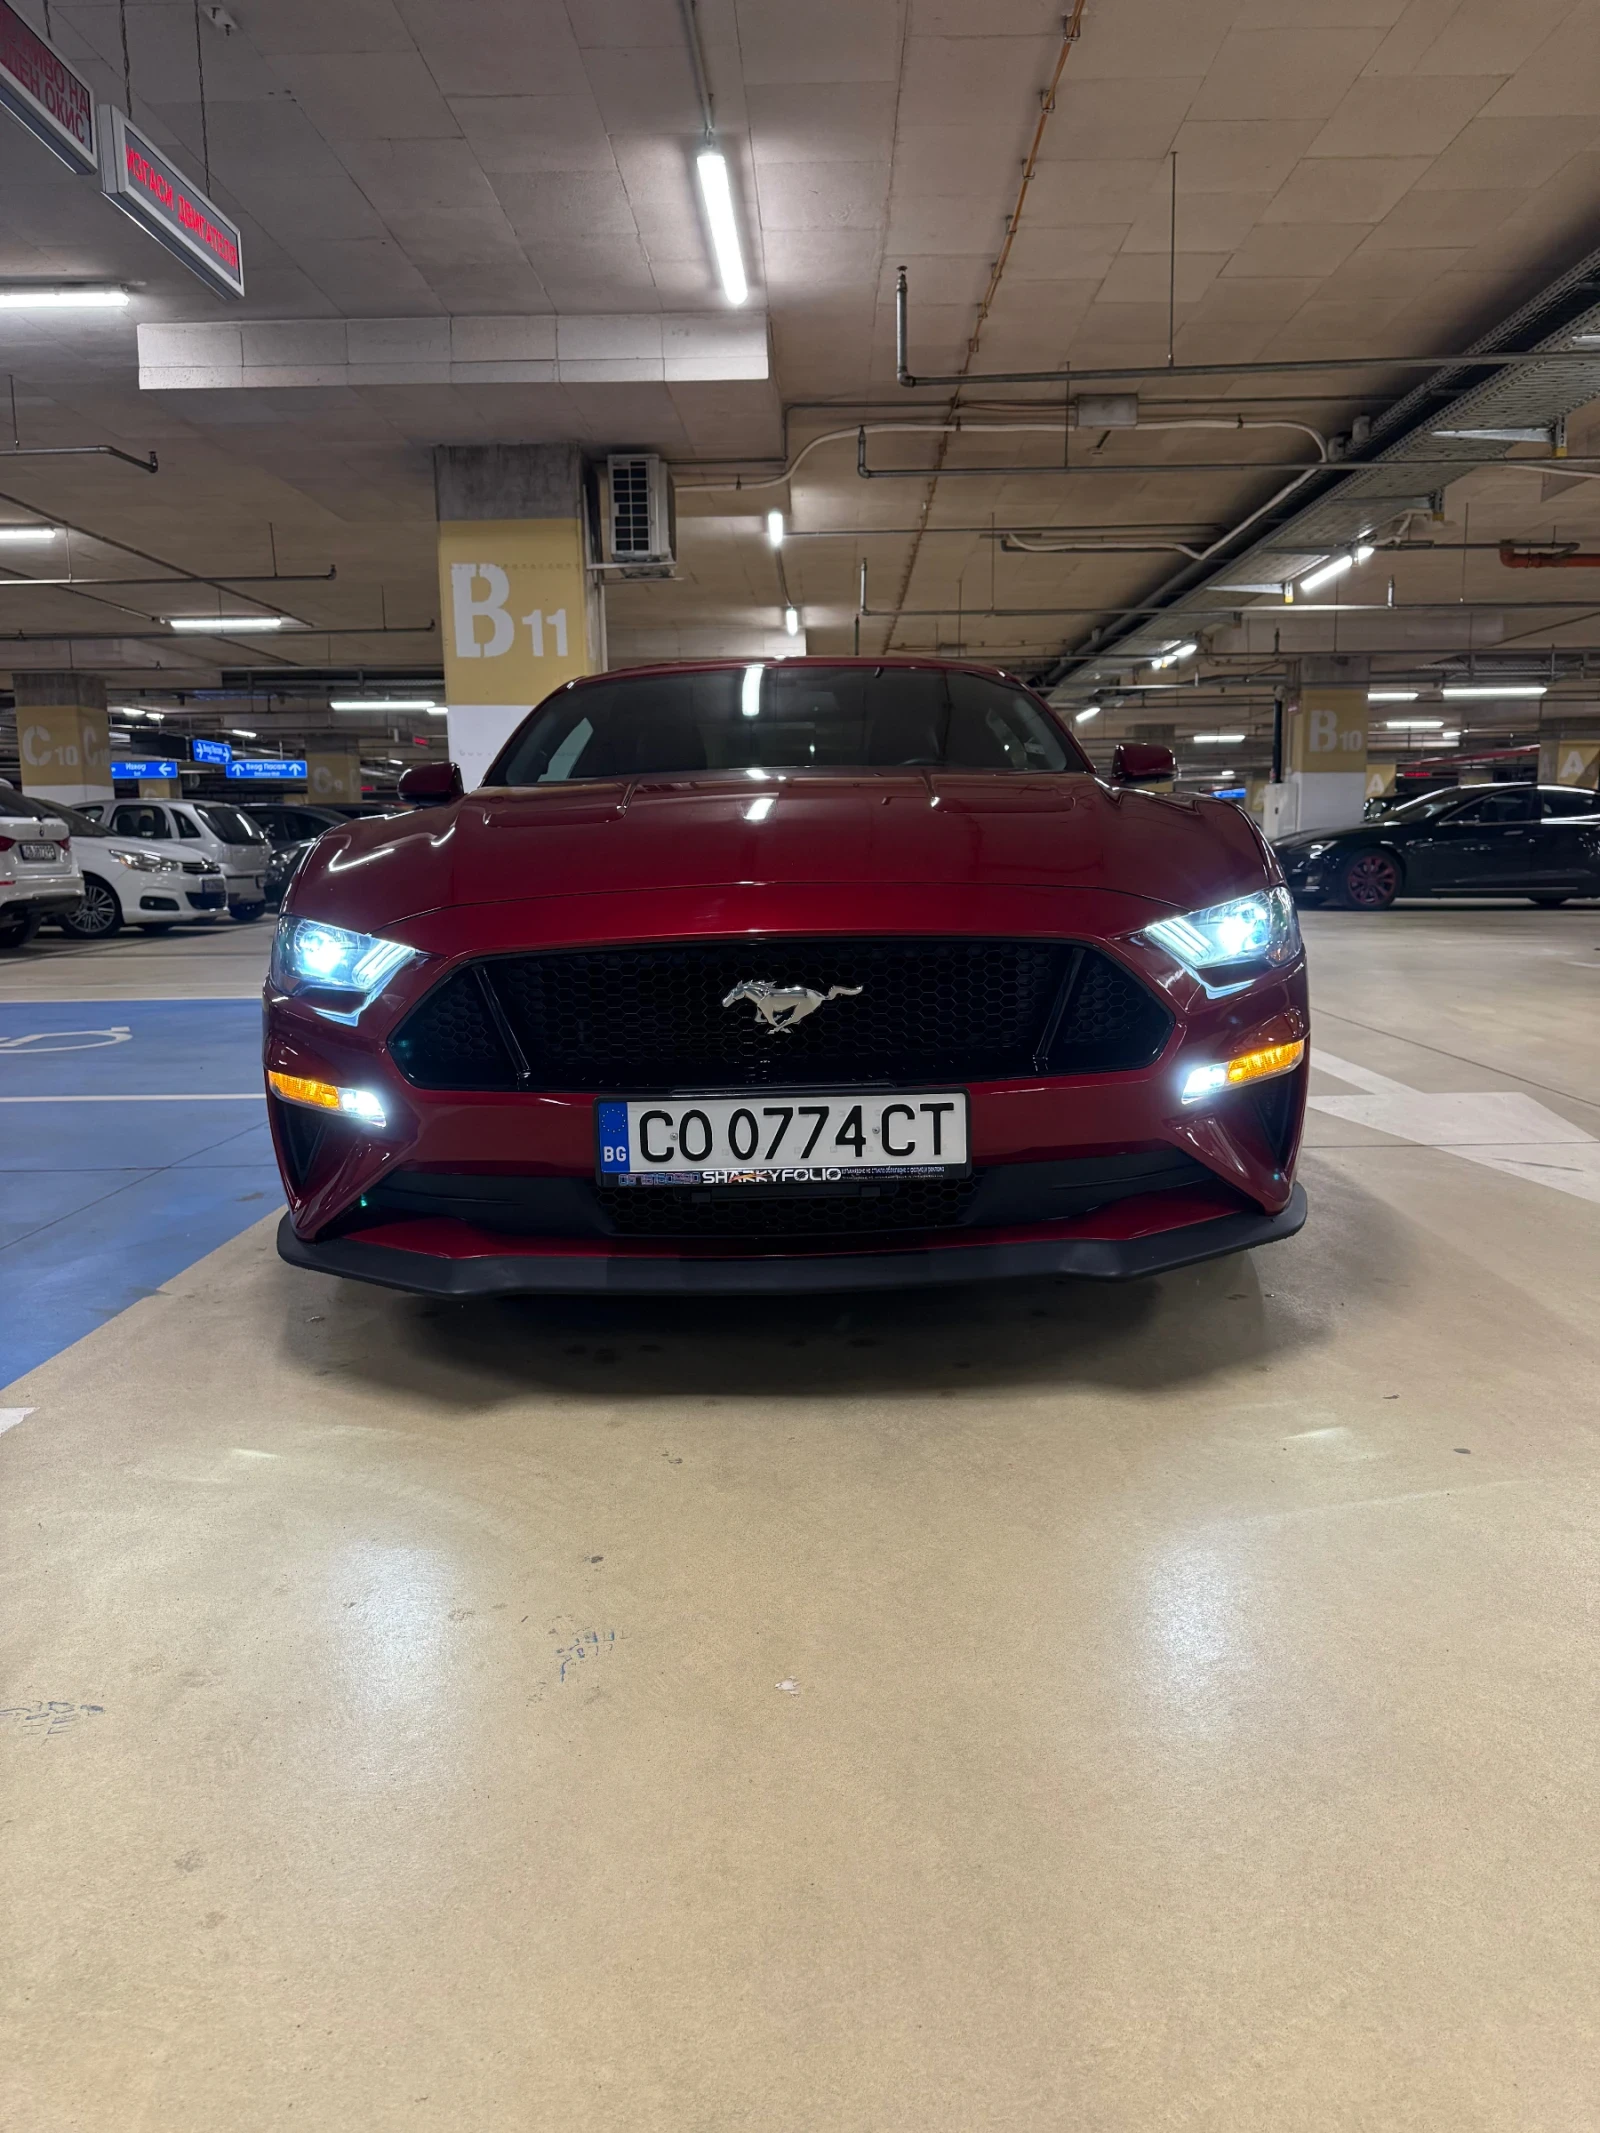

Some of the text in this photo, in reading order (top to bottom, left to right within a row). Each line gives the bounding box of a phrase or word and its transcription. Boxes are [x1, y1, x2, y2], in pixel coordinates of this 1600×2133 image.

[45, 82, 84, 143] ОКИС
[69, 75, 89, 119] НА
[126, 144, 238, 270] ИЗГАСИ ДВИГАТЕЛЯ
[604, 1146, 627, 1162] BG
[639, 1103, 955, 1162] CO 0774 CT
[702, 1167, 842, 1183] SHARKYFOLIO
